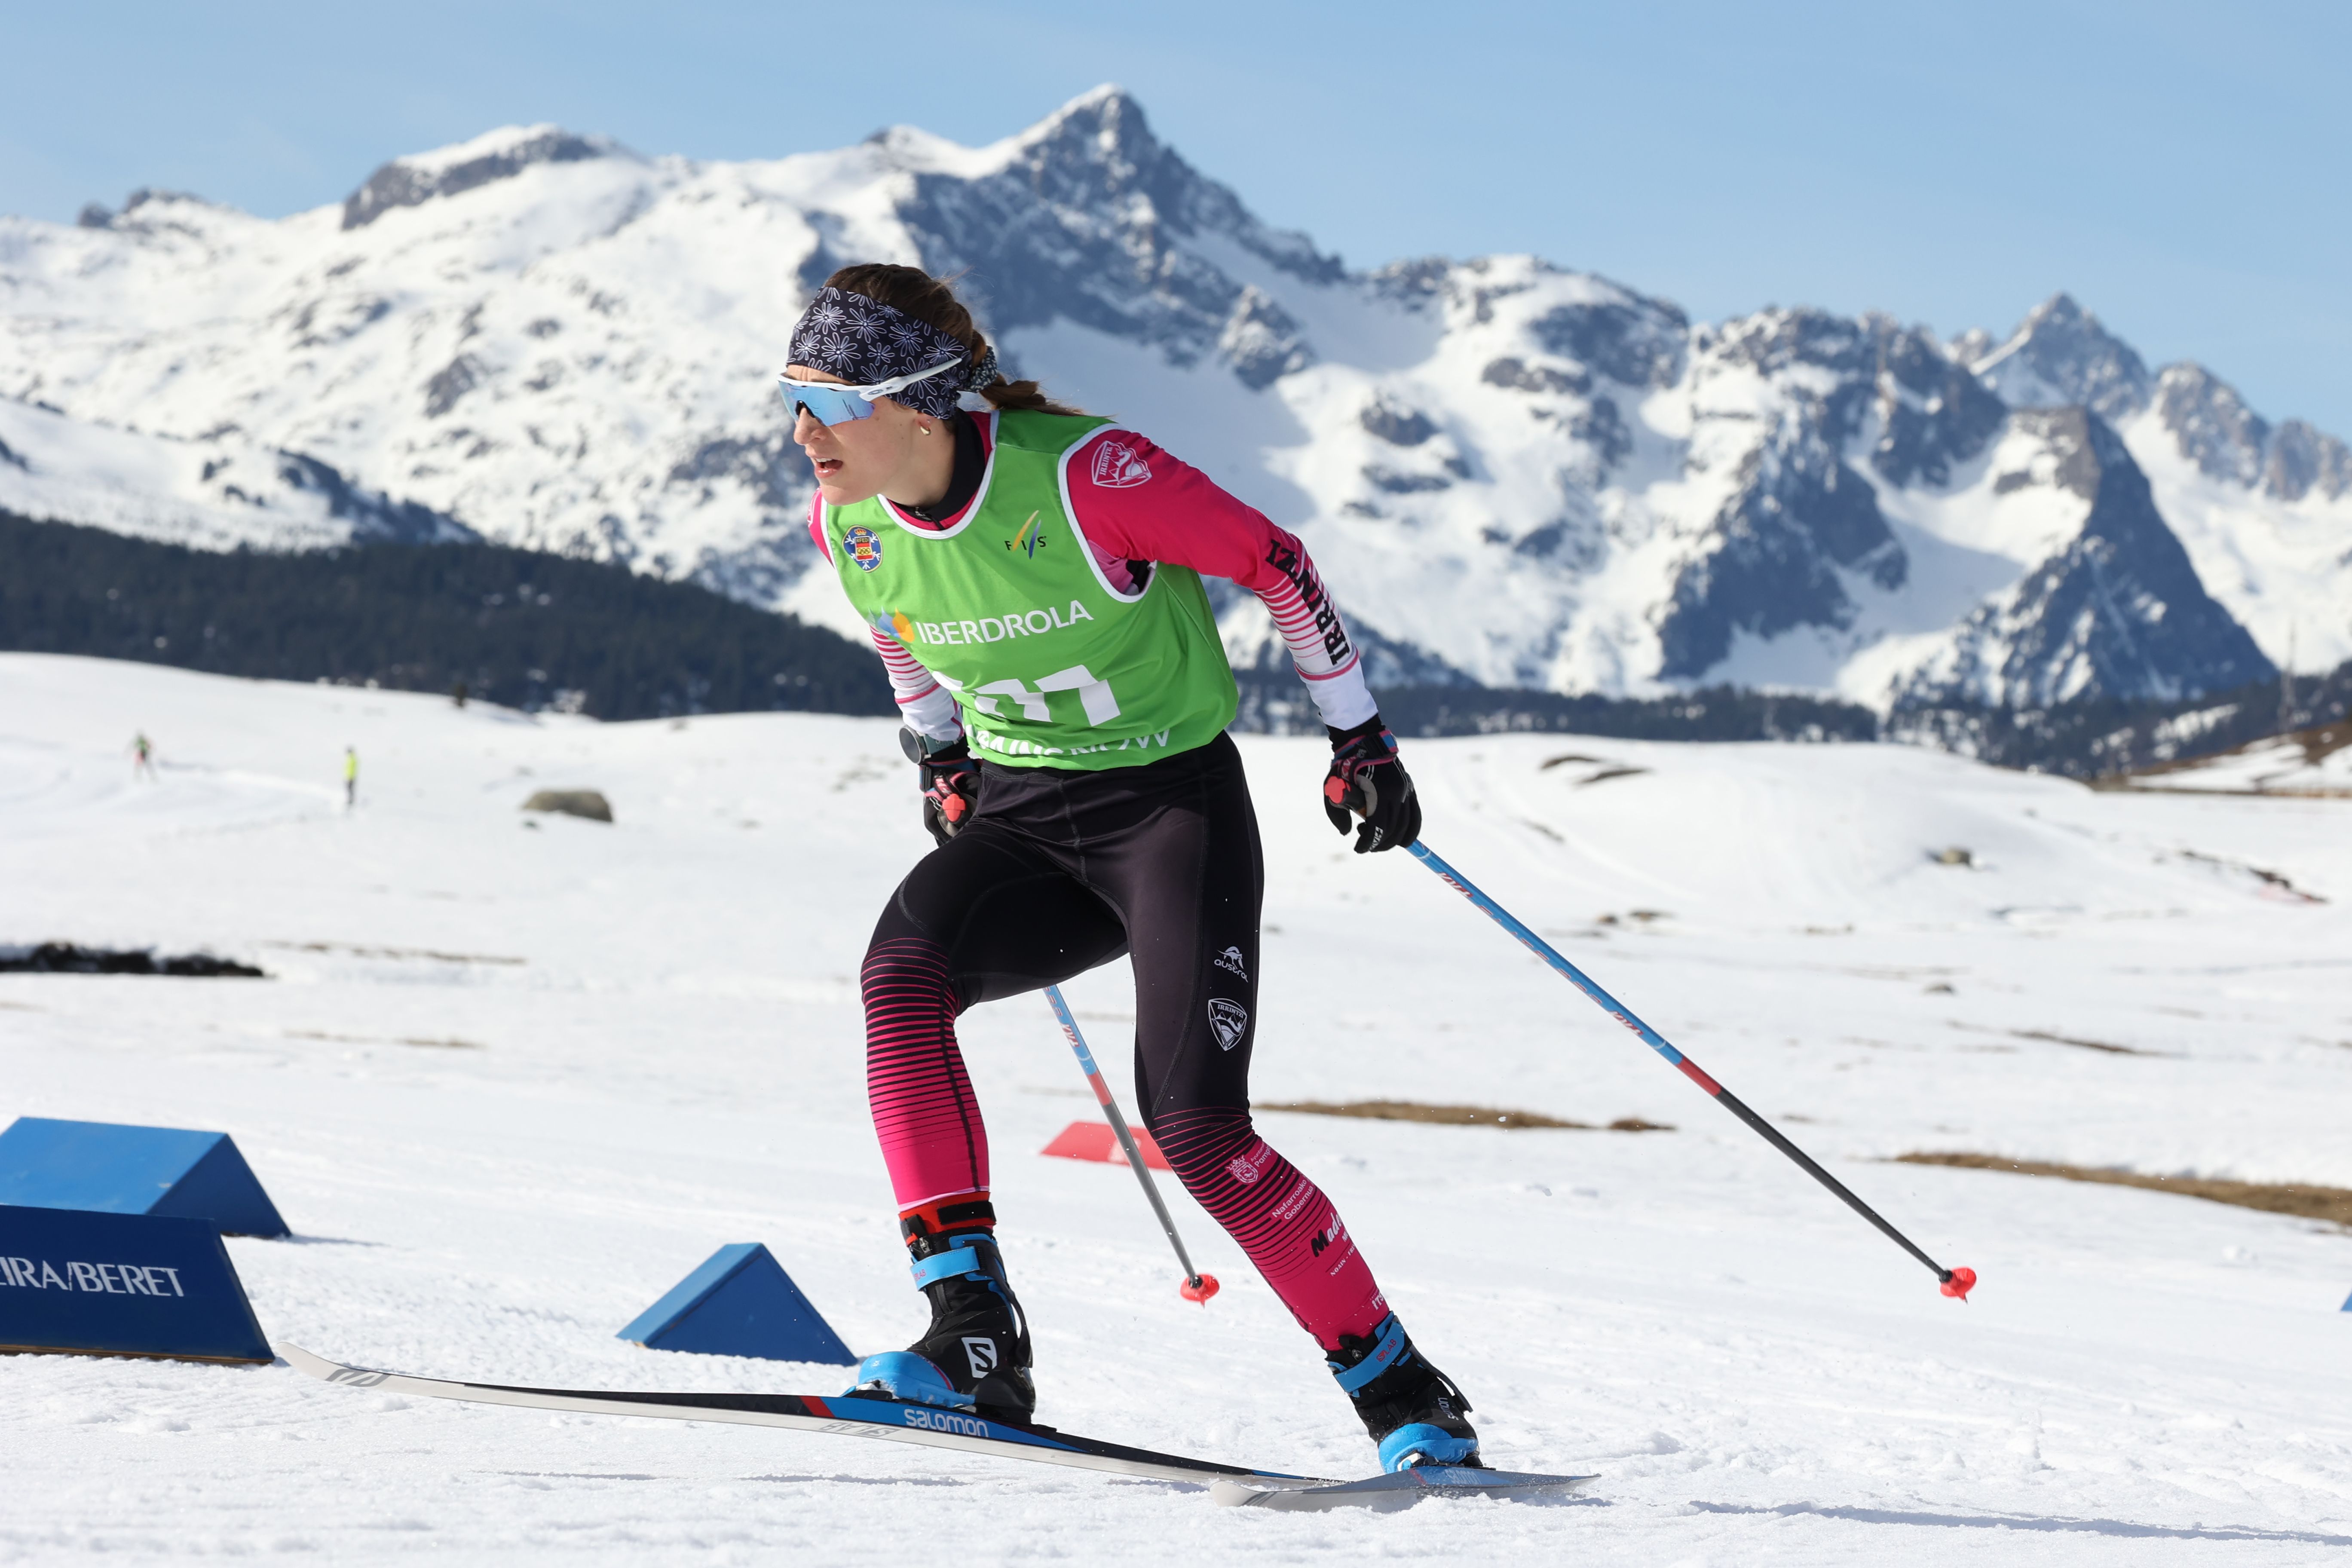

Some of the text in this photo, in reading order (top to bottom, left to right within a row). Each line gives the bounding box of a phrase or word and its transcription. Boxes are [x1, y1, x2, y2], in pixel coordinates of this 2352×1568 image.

[916, 600, 1094, 645] IBERDROLA
[1214, 959, 1248, 983] austral
[1217, 1004, 1244, 1018] IRRINTZI
[1272, 1179, 1307, 1218] Nafarroako
[1284, 1185, 1314, 1219] Gobernua
[0, 1257, 184, 1297] IRA/BERET
[1330, 1259, 1346, 1277] NOAIN
